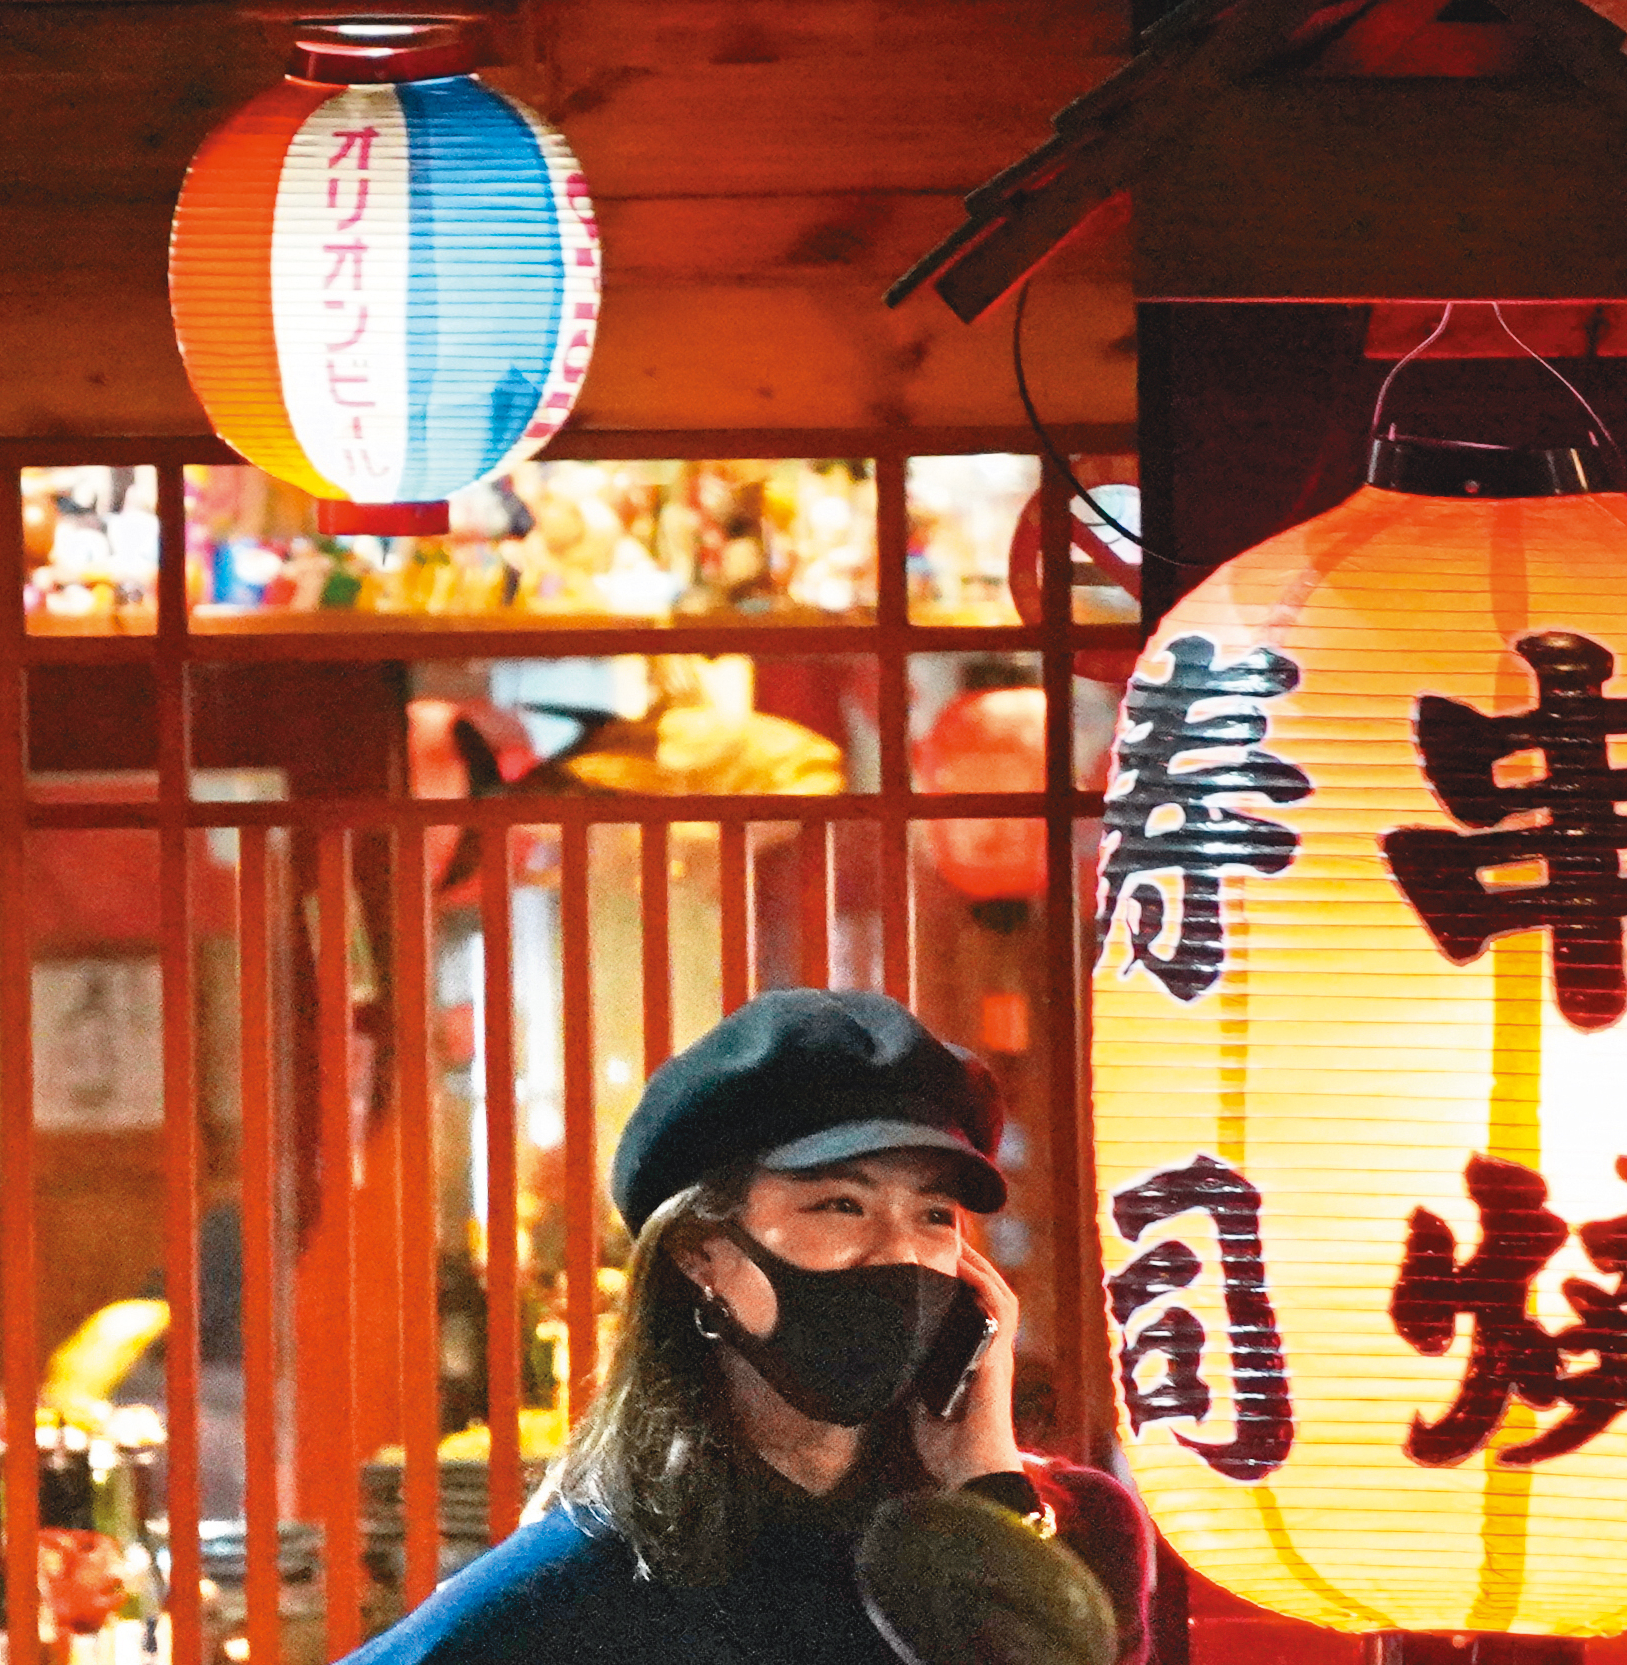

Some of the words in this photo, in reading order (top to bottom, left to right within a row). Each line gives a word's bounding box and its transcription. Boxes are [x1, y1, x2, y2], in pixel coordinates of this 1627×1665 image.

[323, 125, 392, 478] オリオンビール
[1094, 634, 1316, 1480] 寿司
